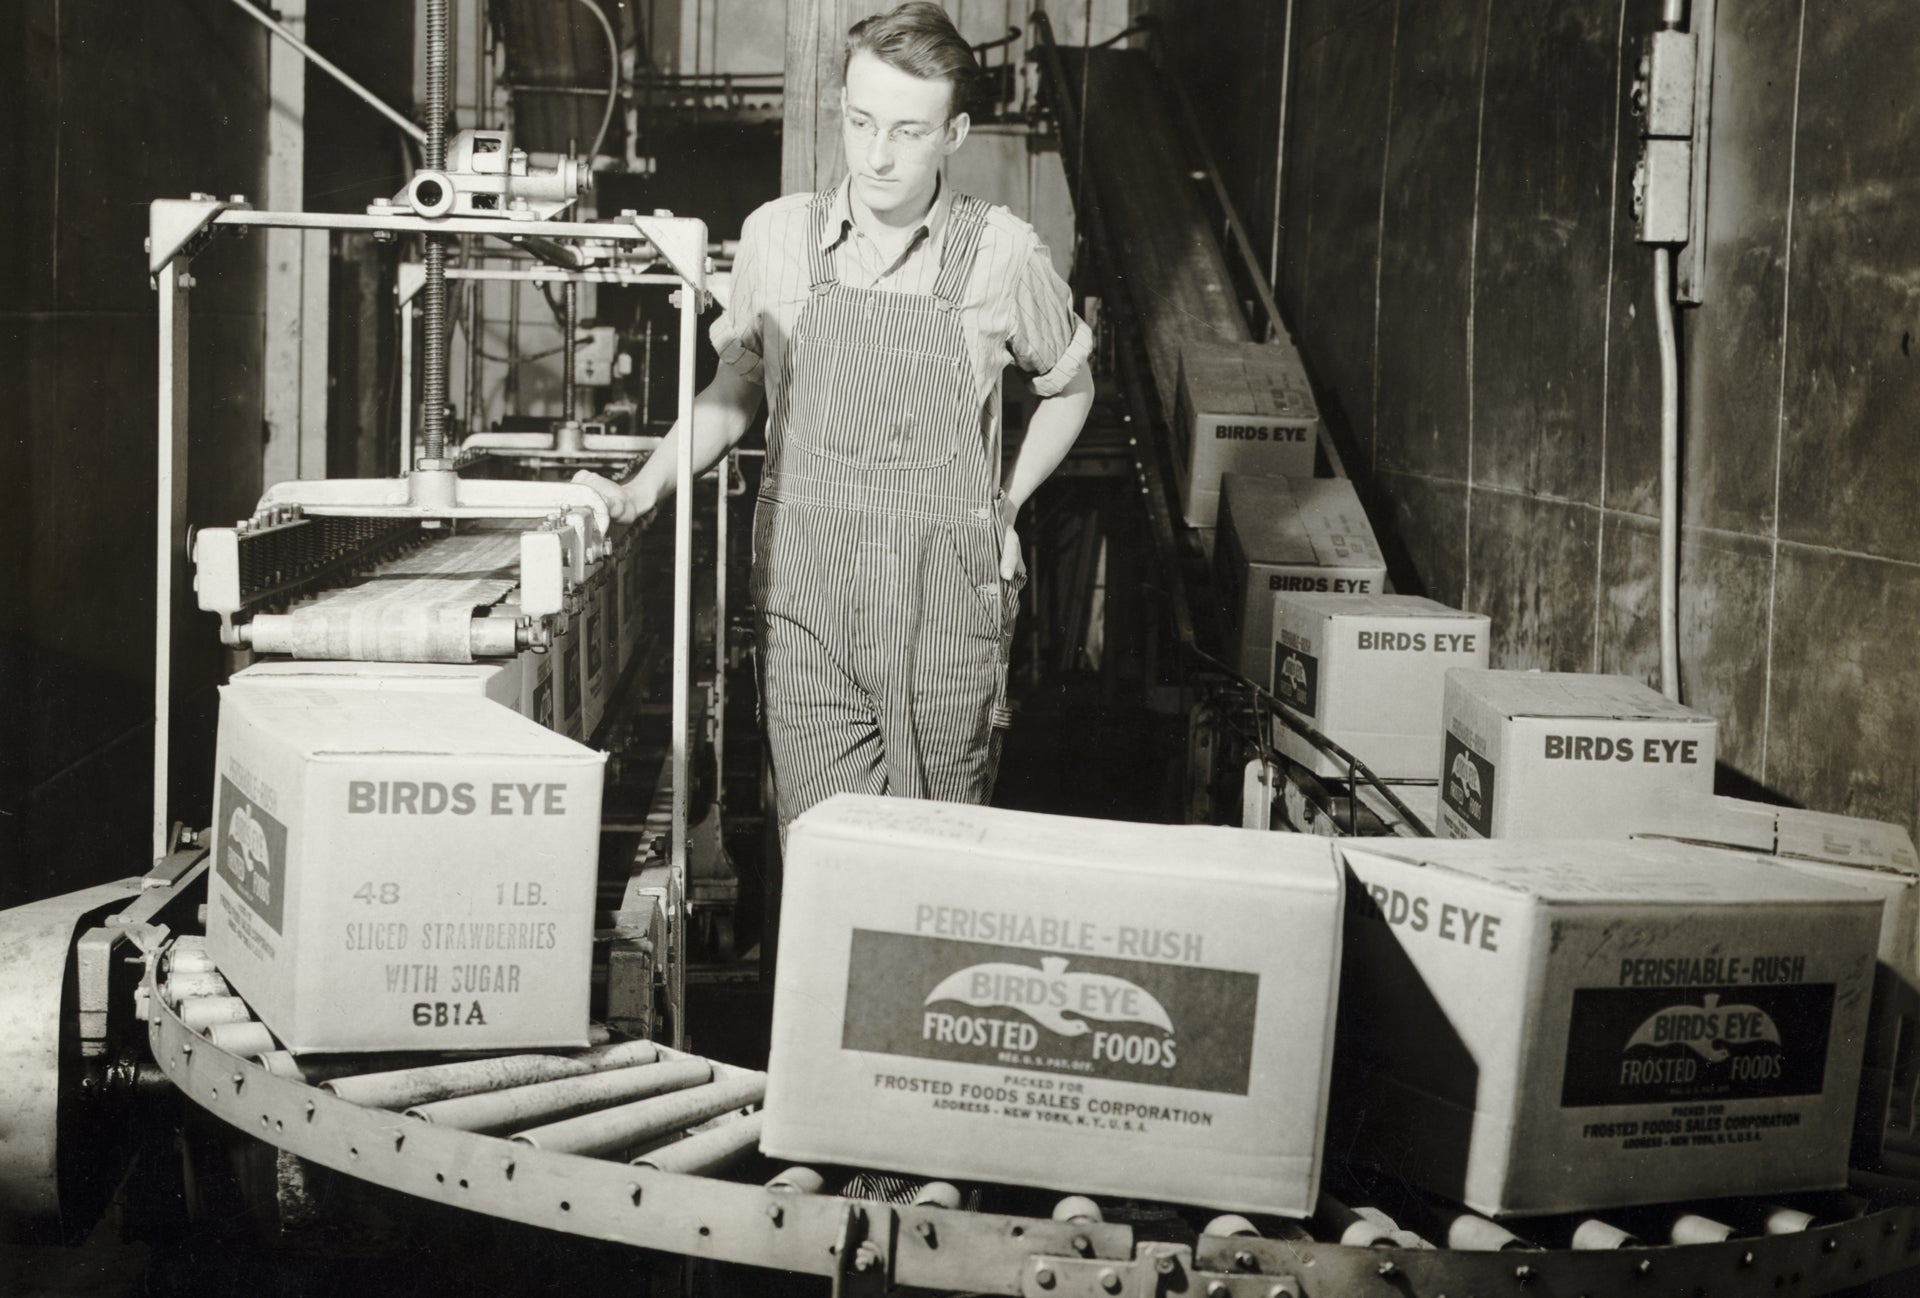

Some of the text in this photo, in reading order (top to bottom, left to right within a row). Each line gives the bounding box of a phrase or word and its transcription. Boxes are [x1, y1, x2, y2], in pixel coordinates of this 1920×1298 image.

[1215, 425, 1307, 442] BIRDS EYE
[1269, 575, 1370, 594] BIRDS EYE
[1357, 631, 1477, 654] BIRDS EYE
[1544, 734, 1699, 765] BIRDS EYE
[348, 780, 567, 815] BIRDS EYE
[353, 882, 400, 905] 48
[345, 922, 556, 950] SLICED STRAWBERRIES
[1438, 903, 1502, 952] EYE
[385, 964, 520, 993] WITH SUGAR
[970, 971, 1141, 1017] BIRDS EYE
[412, 1001, 487, 1027] 6B1A
[1653, 1012, 1763, 1042] BIRDS EYE
[923, 1012, 1176, 1068] FROSTED FOODS
[1620, 1054, 1782, 1085] FROSTED FOODS
[1004, 1075, 1083, 1093] PACKED FOR
[874, 1074, 1213, 1126] FROSTED FOODS SALES CORPORATION
[932, 1099, 990, 1114] ADDRESS
[1003, 1107, 1031, 1119] NEW
[1582, 1112, 1801, 1138] FROSTED FOODS SALES CORPORATION
